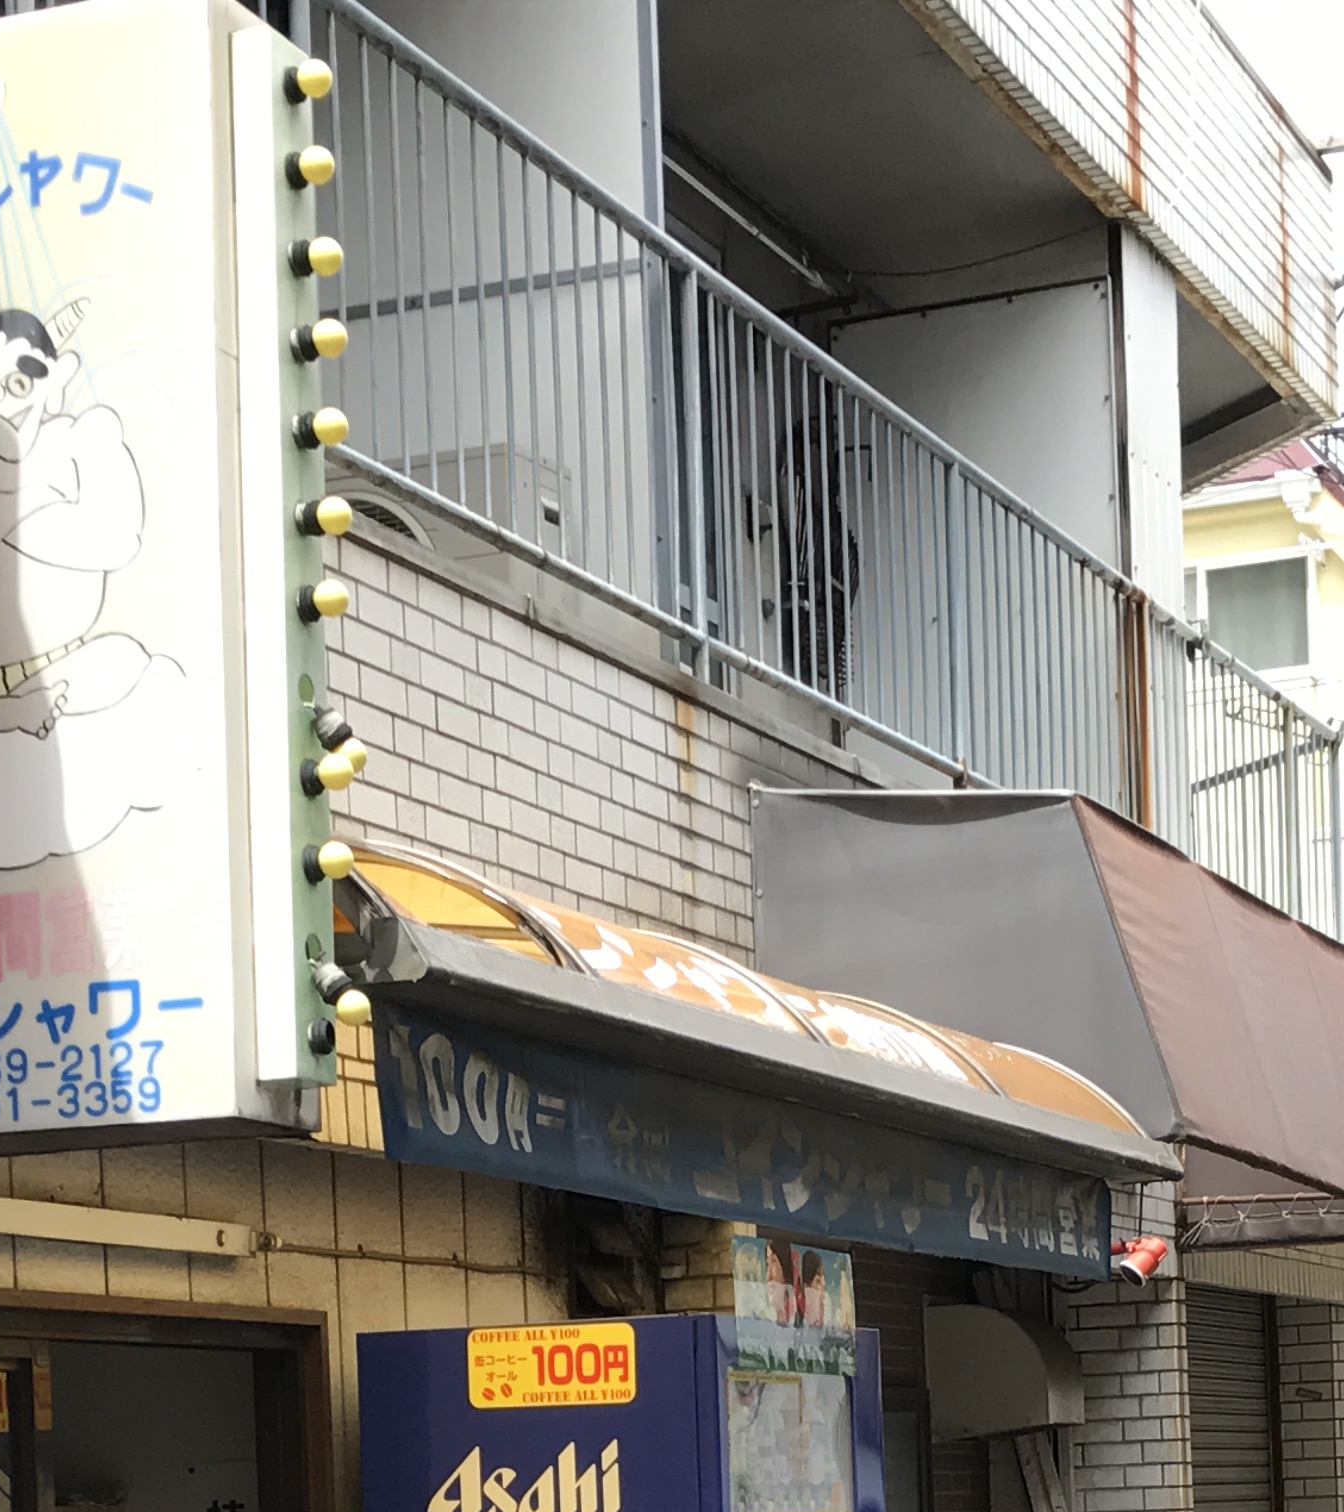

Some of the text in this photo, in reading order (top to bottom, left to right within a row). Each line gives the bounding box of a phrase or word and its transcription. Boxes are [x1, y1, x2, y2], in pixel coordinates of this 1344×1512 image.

[471, 1330, 520, 1344] COFFEE
[523, 1329, 547, 1341] ALL
[531, 1343, 629, 1387] 100円
[485, 1370, 518, 1383] オール
[522, 1390, 569, 1404] COFFEE
[575, 1389, 597, 1402] ALL
